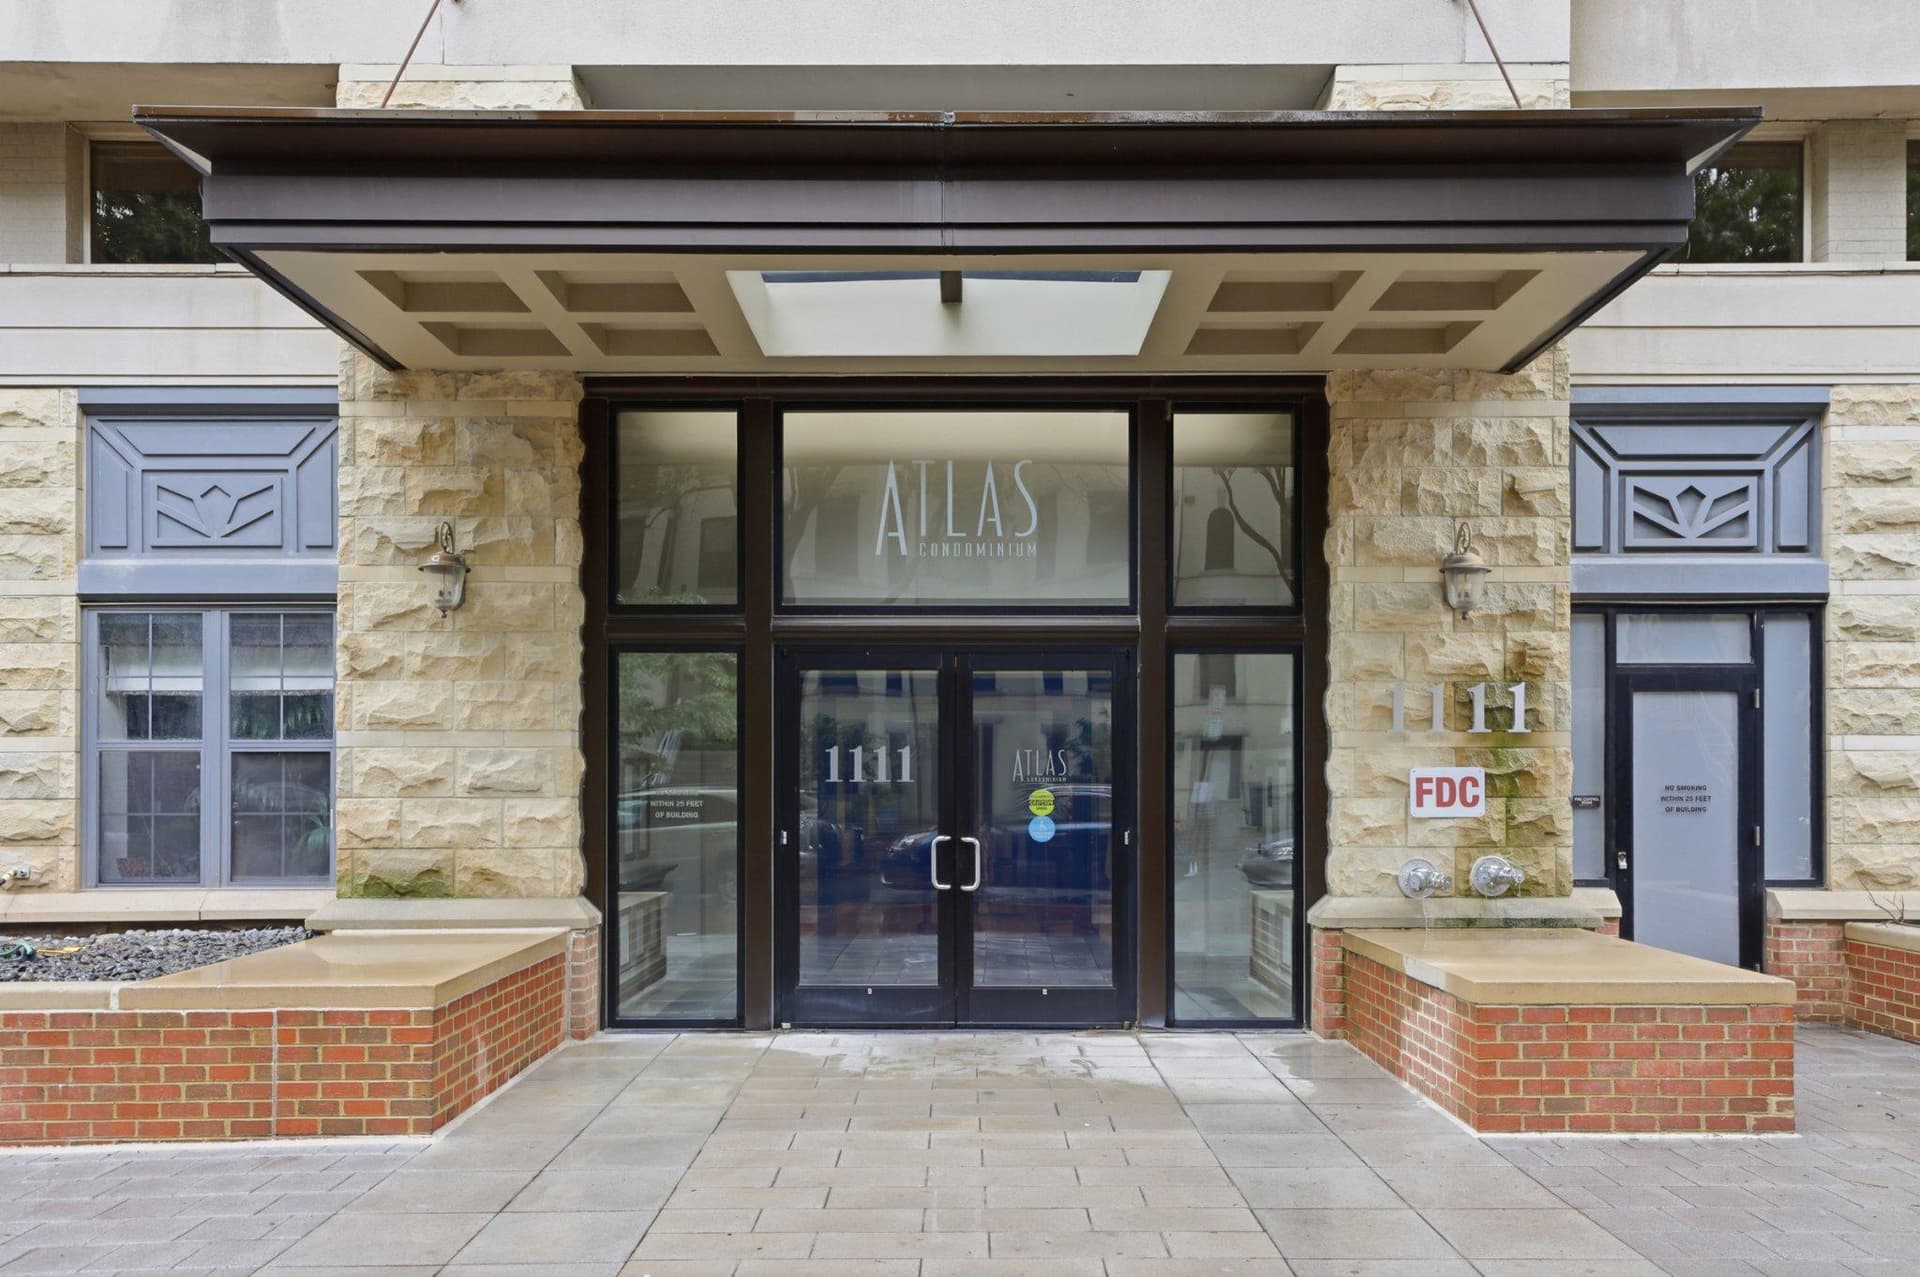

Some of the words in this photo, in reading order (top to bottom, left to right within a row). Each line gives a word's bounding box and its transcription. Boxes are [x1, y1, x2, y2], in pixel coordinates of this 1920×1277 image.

[875, 459, 1038, 556] ATLAS
[919, 542, 1038, 557] CONDOMINIUM
[1385, 682, 1532, 734] 1111
[825, 745, 915, 783] 1111
[1012, 748, 1067, 782] ATLAS
[1415, 775, 1480, 808] FDC
